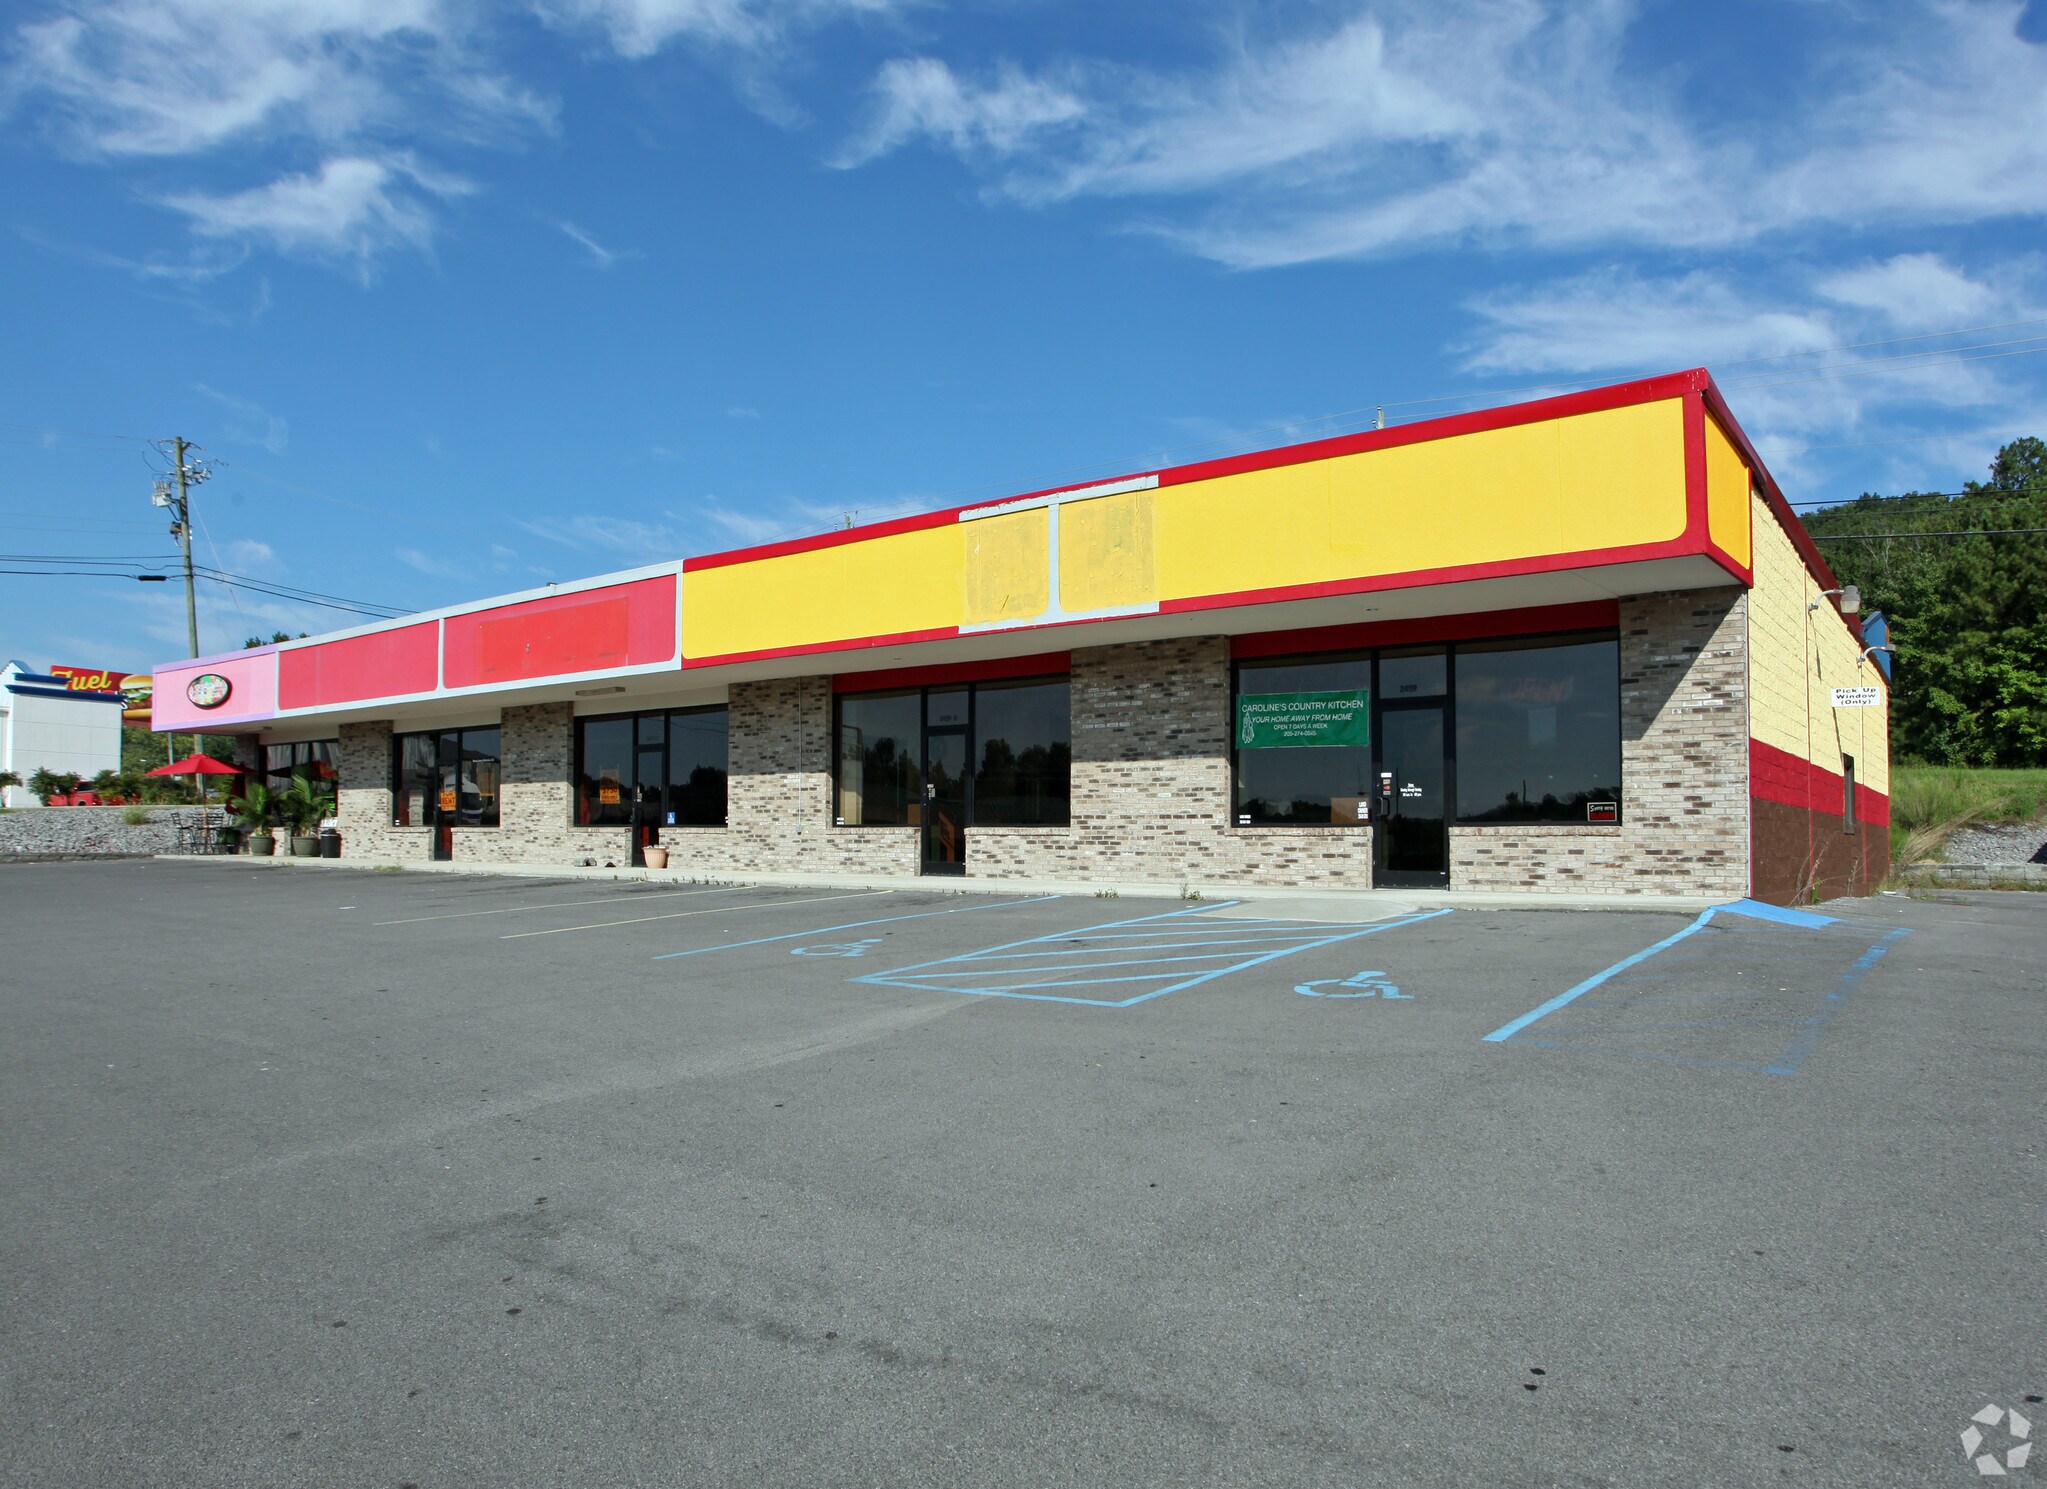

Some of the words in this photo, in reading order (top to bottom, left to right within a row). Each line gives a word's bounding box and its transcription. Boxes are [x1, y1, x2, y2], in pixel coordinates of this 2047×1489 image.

[1242, 703, 1287, 712] CAROLINE'S
[1288, 701, 1326, 711] COUNTRY
[1327, 700, 1364, 709] KITCHEN
[1270, 715, 1290, 723] HOME
[1291, 714, 1311, 722] AWAY
